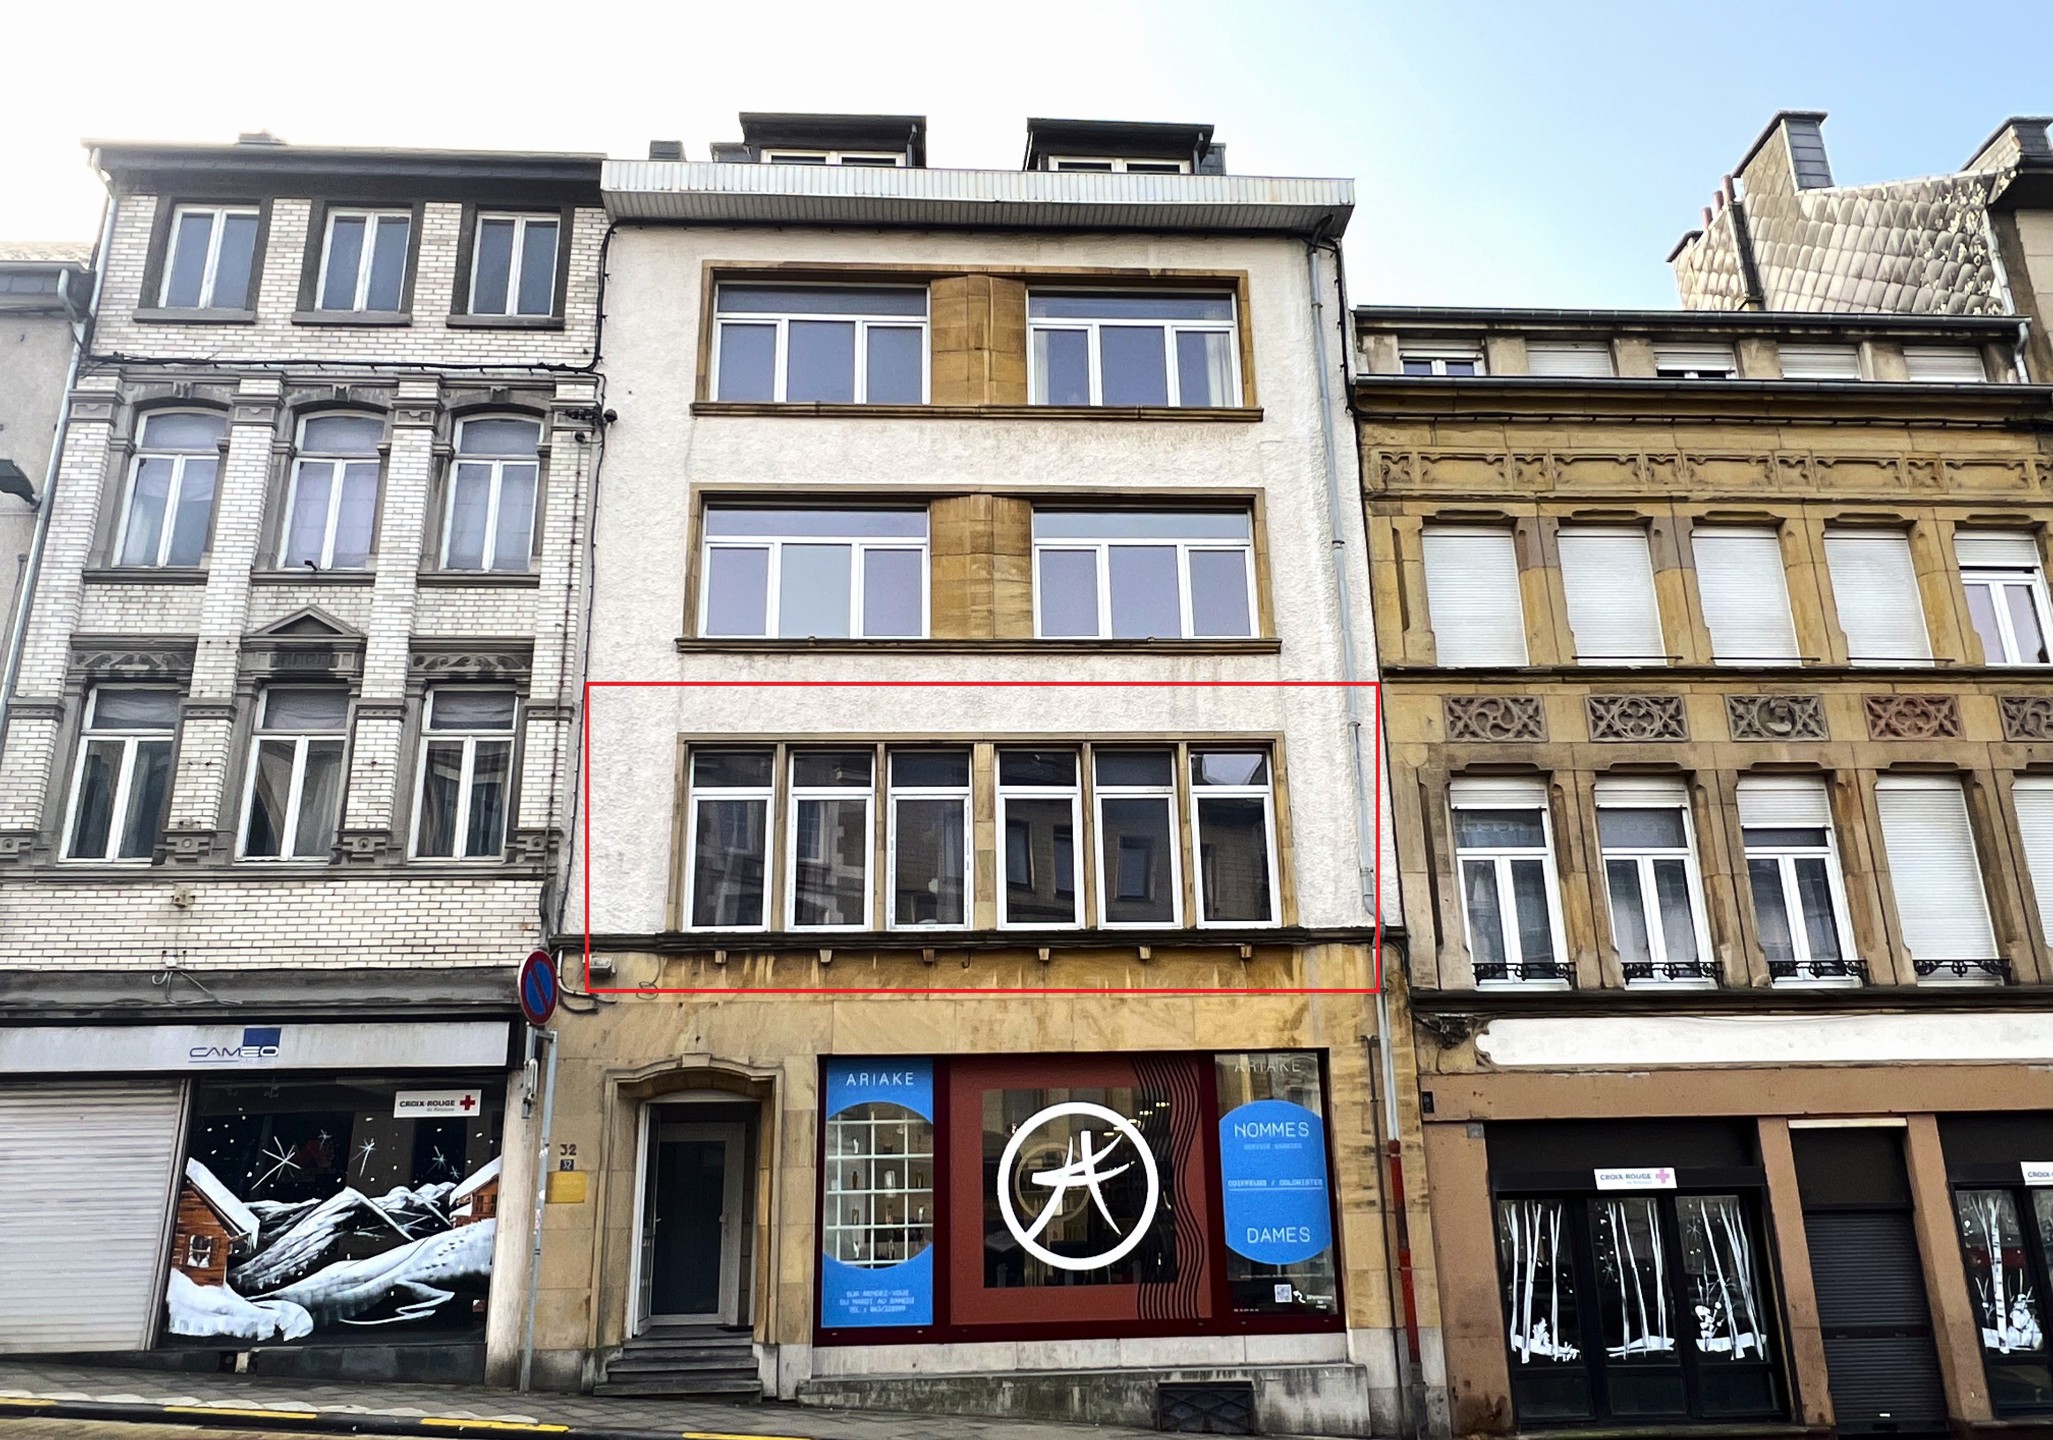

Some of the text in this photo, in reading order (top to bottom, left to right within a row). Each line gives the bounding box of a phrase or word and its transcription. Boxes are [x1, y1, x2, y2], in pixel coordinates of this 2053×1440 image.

[190, 1046, 279, 1058] CAMEO
[1234, 1059, 1302, 1073] ARIAKE
[845, 1072, 915, 1087] ARIAKE
[560, 1143, 577, 1156] 32
[1246, 1226, 1311, 1243] DAMES
